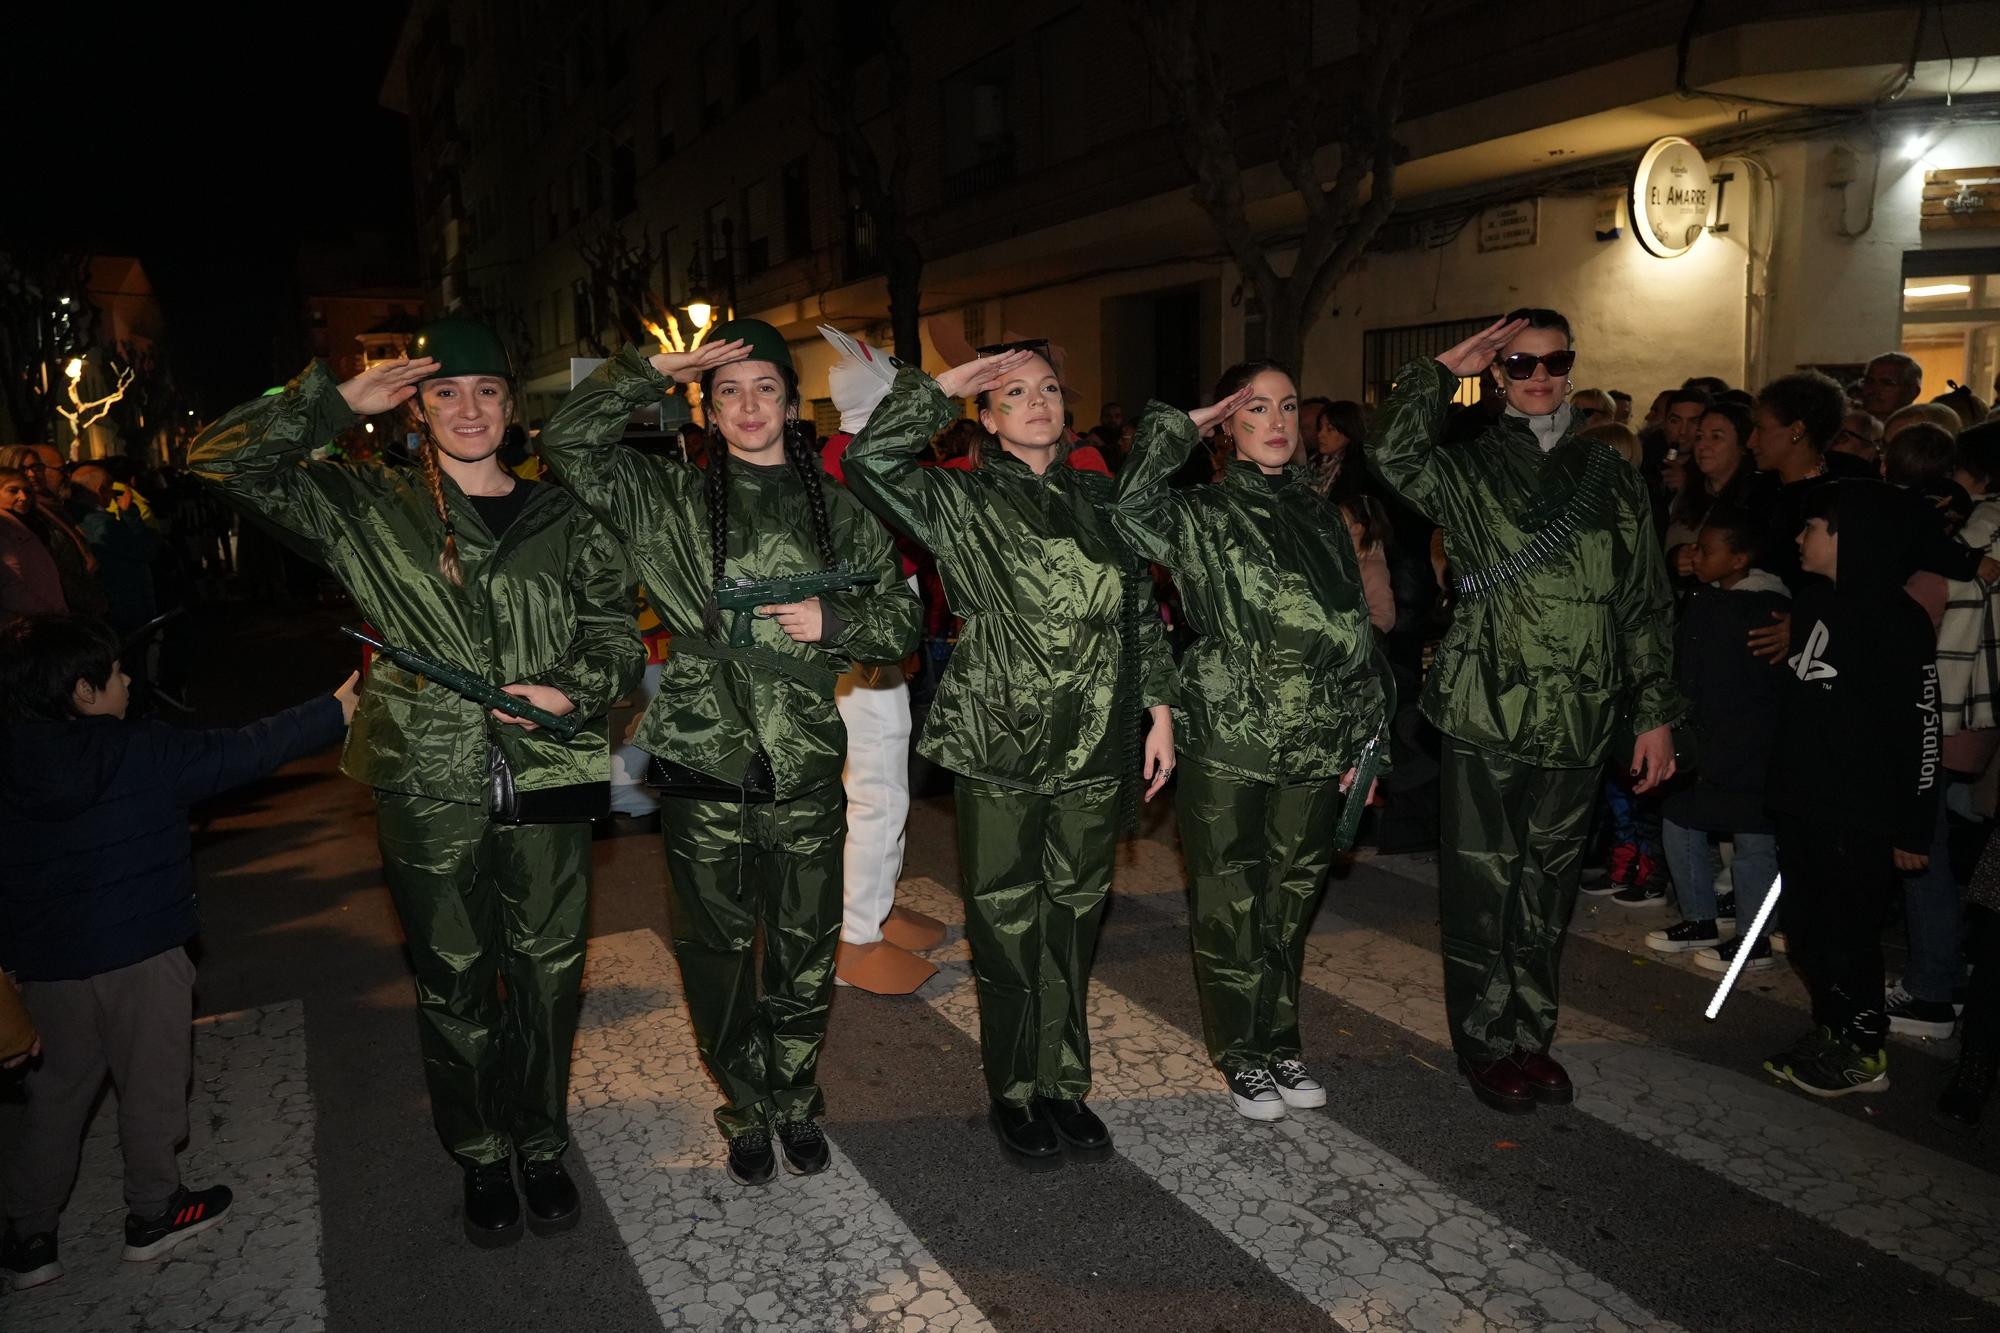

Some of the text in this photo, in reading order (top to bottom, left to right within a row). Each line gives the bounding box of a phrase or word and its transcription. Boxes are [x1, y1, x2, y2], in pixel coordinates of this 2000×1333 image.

[1651, 186, 1706, 205] EL AMARRE
[1916, 664, 1940, 790] PlayStation
